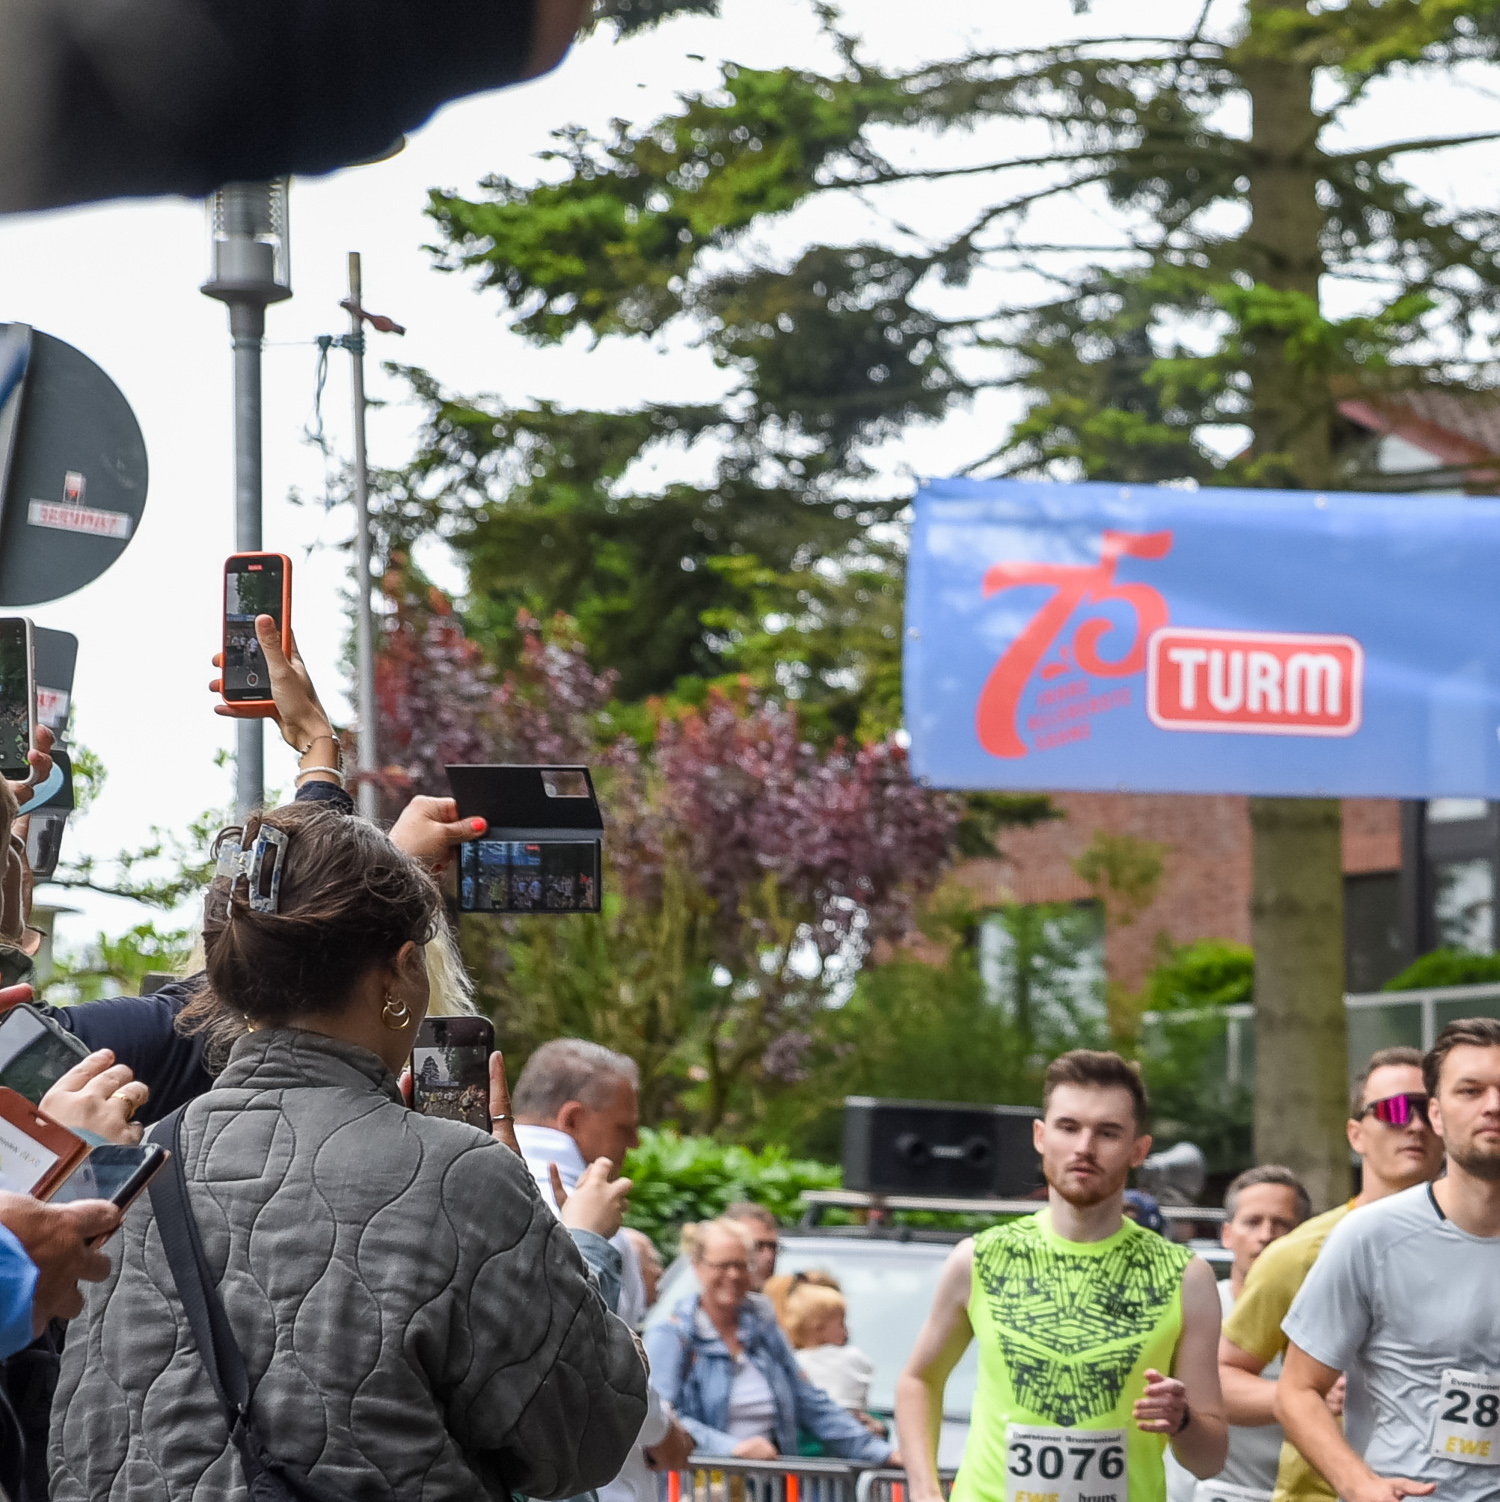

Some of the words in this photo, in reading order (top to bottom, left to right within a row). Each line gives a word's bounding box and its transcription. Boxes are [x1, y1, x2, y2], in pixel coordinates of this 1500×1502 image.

[1168, 648, 1342, 717] TURM
[1008, 1443, 1125, 1481] 3076
[1445, 1436, 1492, 1457] EWE
